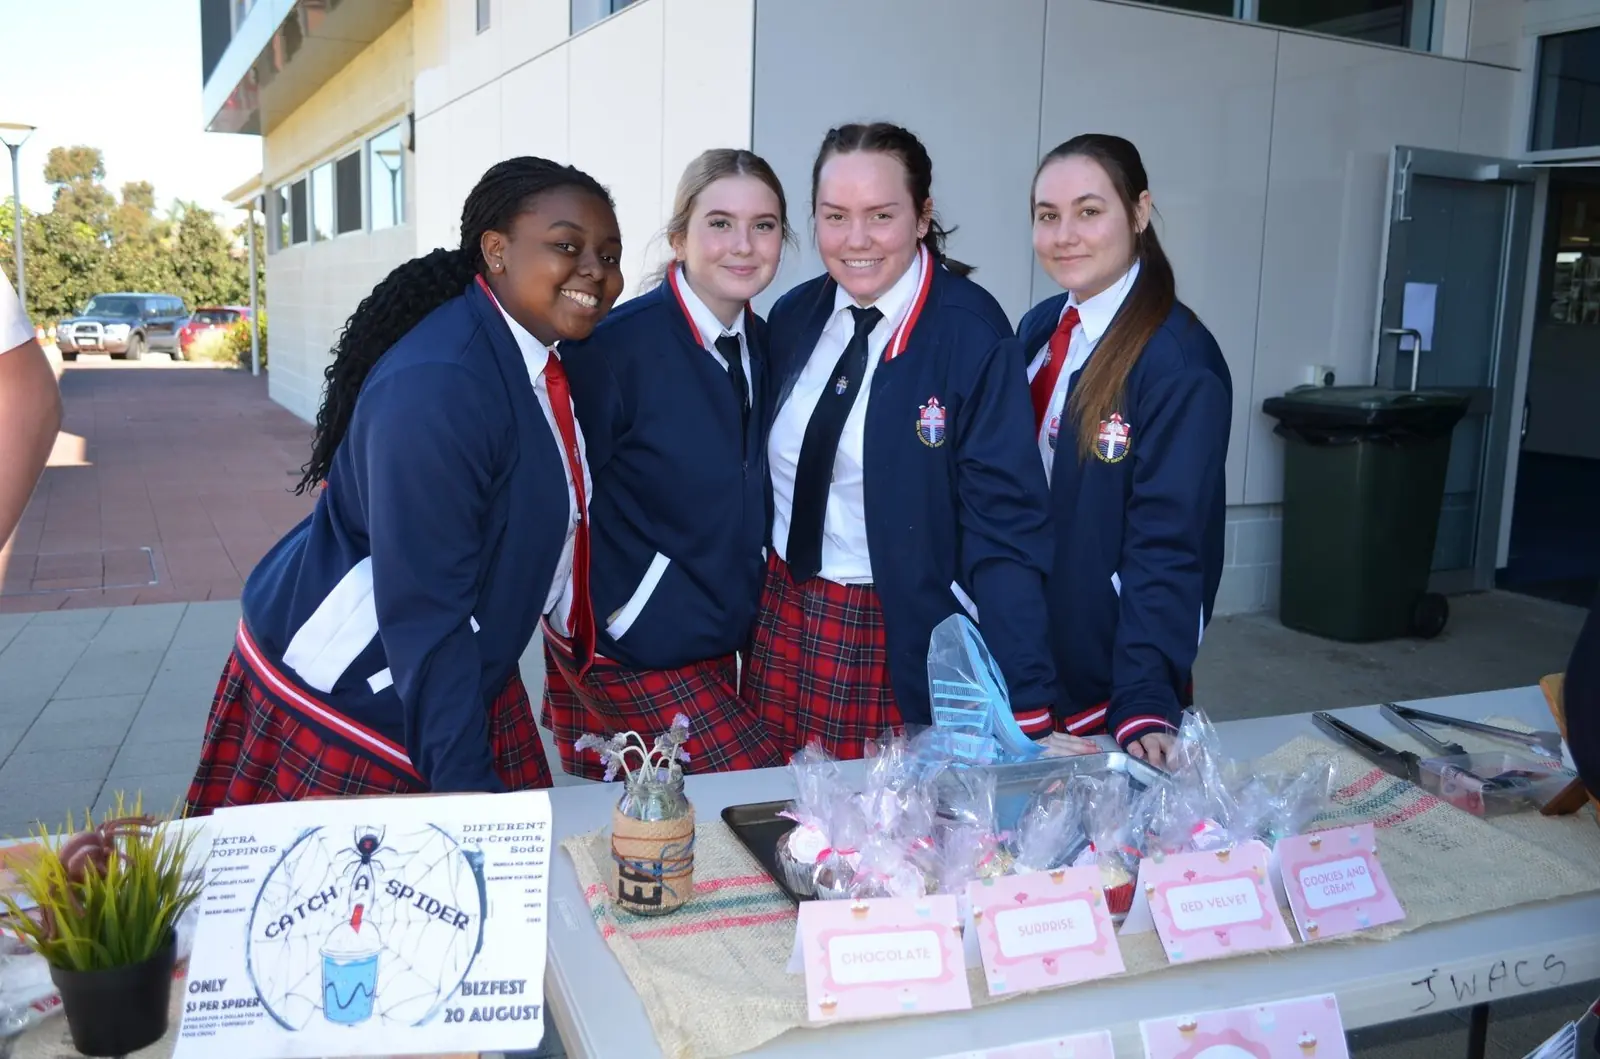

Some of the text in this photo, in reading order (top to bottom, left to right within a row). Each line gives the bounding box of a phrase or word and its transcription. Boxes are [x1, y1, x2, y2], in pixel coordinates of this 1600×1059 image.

[462, 821, 546, 832] DIFFERENT
[212, 835, 256, 846] EXTRA
[212, 845, 277, 858] TOPPINGS
[510, 844, 544, 854] Soda
[355, 875, 369, 891] A
[1303, 865, 1366, 888] COOKIES AND
[1322, 881, 1356, 897] CREAM
[385, 878, 470, 931] SPIDER
[1180, 893, 1248, 914] RED VELVET
[265, 885, 338, 939] CATCH
[1018, 918, 1076, 938] SURPRISE
[841, 947, 931, 965] CHOCOLATE
[188, 978, 227, 994] ONLY
[461, 979, 527, 996] BIZFEST
[186, 997, 260, 1013] $3 PER SPIDER
[444, 1004, 541, 1023] 20 AUGUST
